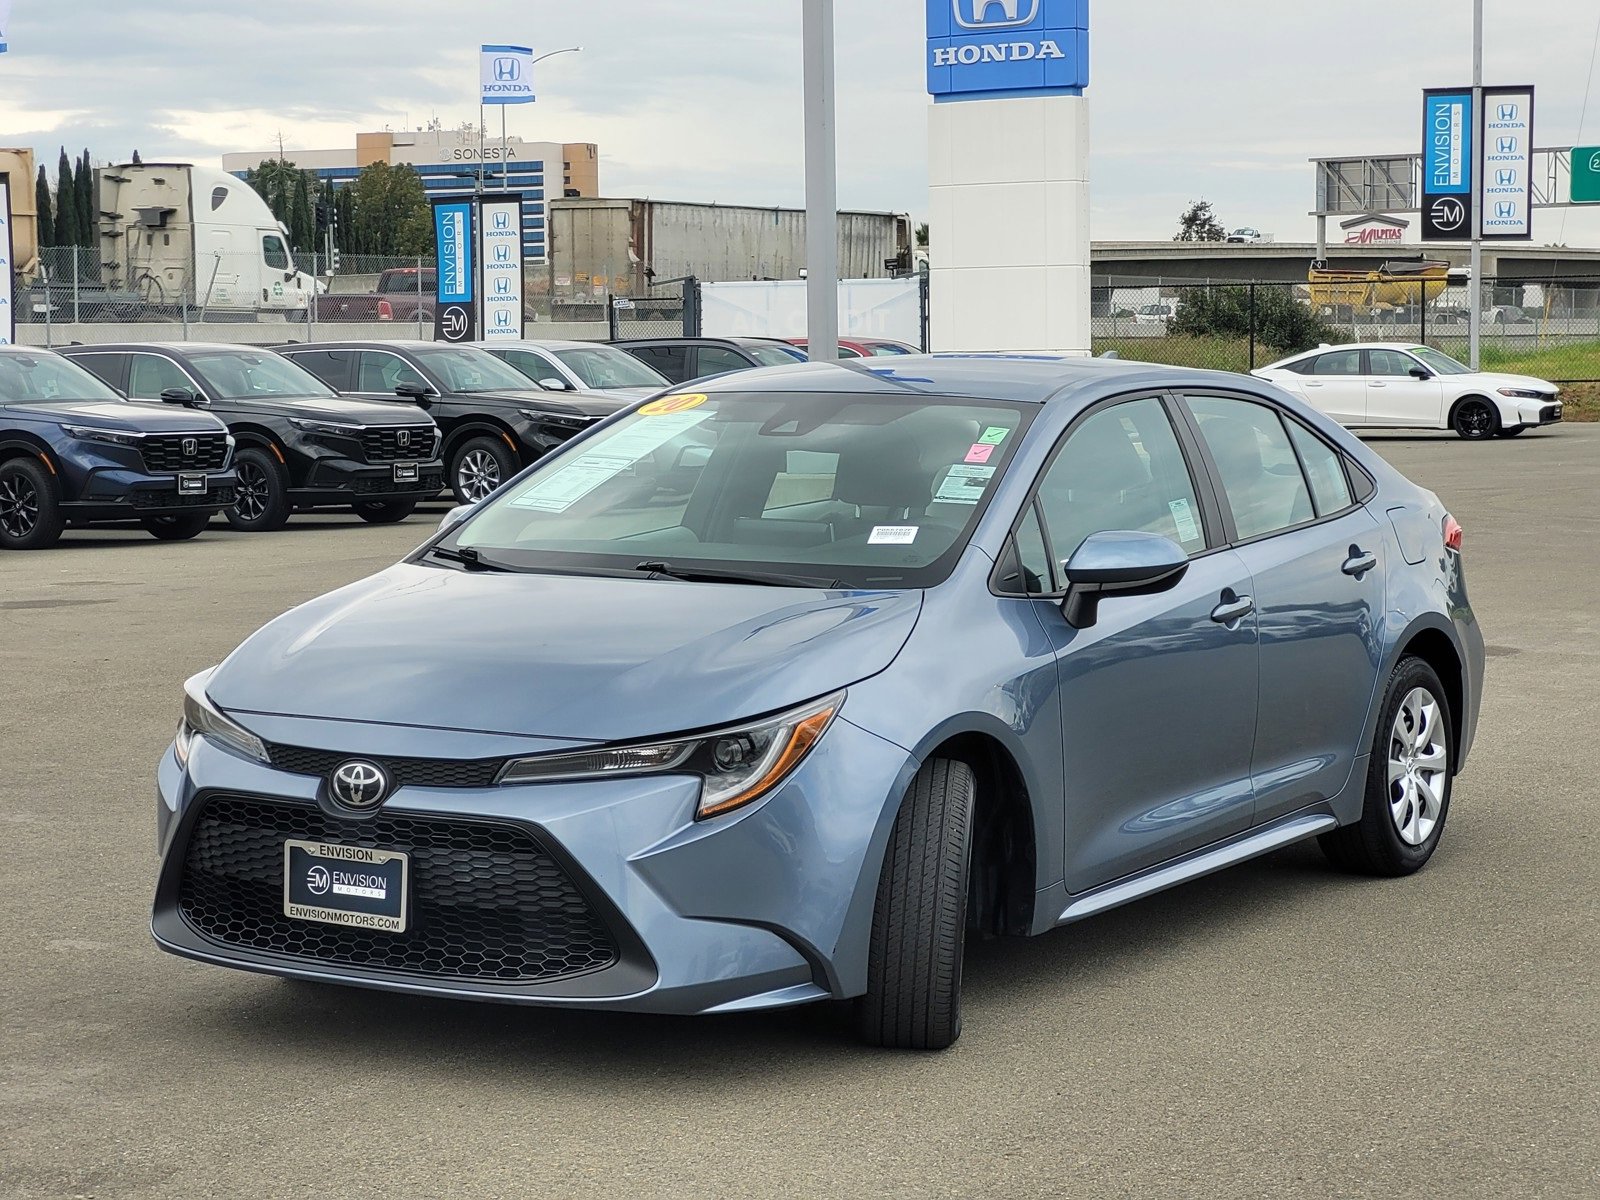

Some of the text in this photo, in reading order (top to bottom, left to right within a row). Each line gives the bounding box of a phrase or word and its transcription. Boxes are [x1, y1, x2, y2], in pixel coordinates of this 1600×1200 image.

[933, 40, 1065, 66] HONDA
[483, 84, 532, 92] HONDA
[1434, 103, 1450, 186] ENVISION
[442, 212, 455, 295] ENVISION
[785, 308, 891, 334] CDIT
[319, 845, 373, 861] ENVISION
[332, 871, 387, 889] ENVISION
[337, 884, 382, 897] MOTORS
[289, 906, 400, 930] ENVISIONMOTORS.COM
